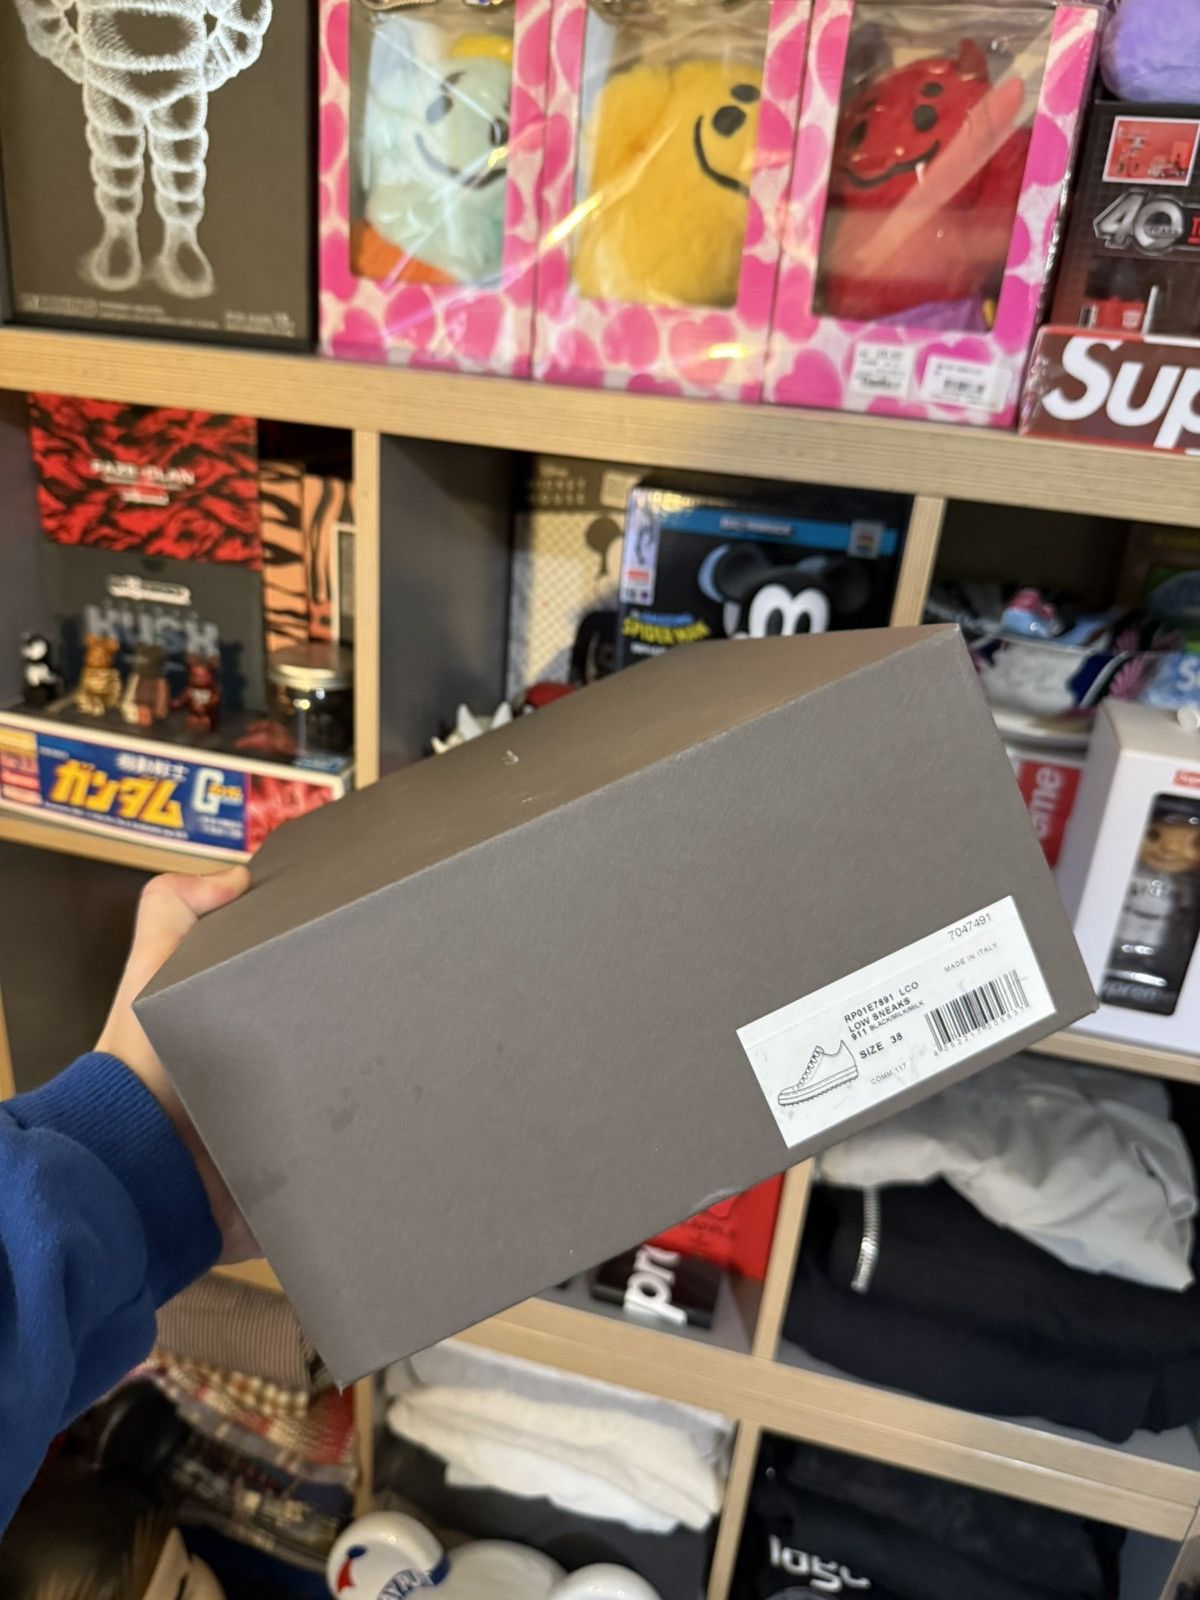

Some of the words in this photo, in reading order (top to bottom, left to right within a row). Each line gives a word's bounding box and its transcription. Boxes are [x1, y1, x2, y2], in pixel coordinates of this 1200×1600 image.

[1175, 655, 1200, 692] S
[51, 758, 185, 828] ガンダム
[947, 912, 992, 941] 7047491
[944, 957, 966, 973] MADE
[977, 942, 998, 956] ITALY
[898, 981, 919, 997] LCO
[848, 1016, 870, 1034] LOW
[872, 997, 911, 1021] SNEAKS
[850, 1028, 868, 1041] 911
[860, 1041, 884, 1059] SIZE
[890, 1031, 903, 1044] 38
[895, 1062, 906, 1073] 117
